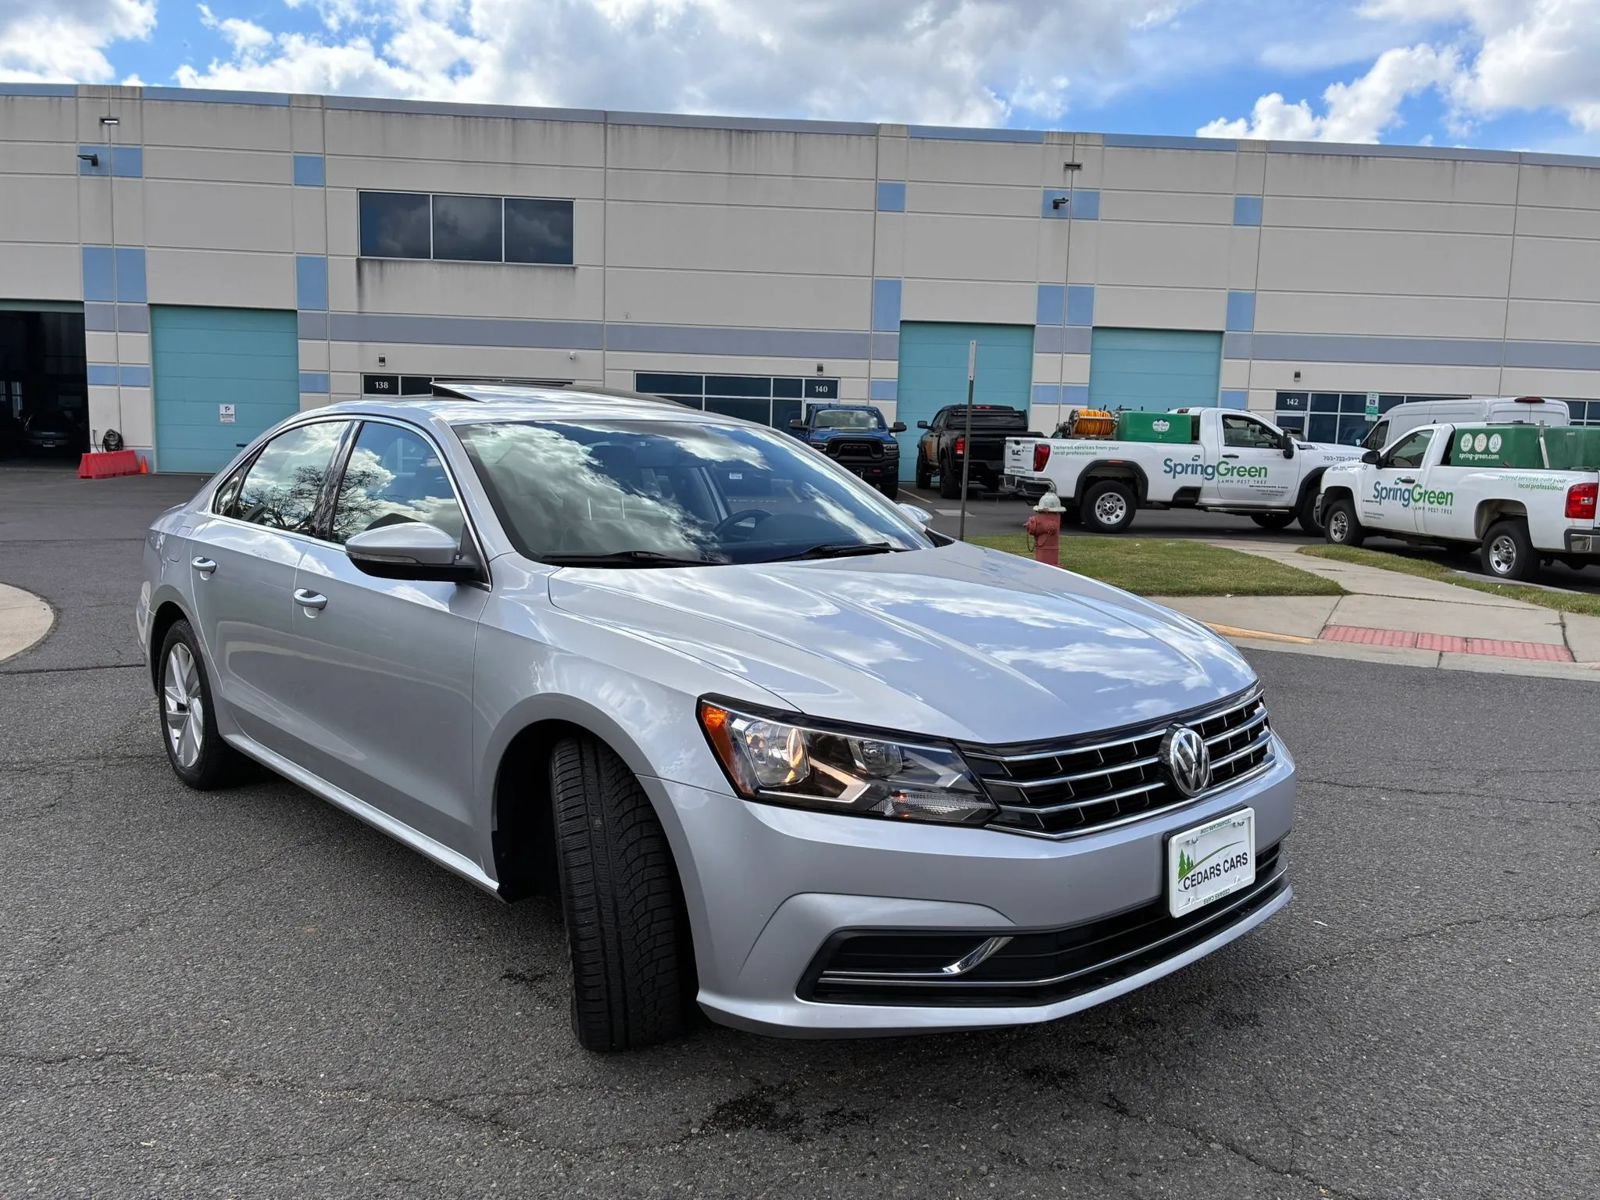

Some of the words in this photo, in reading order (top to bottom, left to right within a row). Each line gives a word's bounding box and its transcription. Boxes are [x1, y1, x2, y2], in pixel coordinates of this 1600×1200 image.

[375, 381, 389, 389] 138
[815, 385, 829, 393] 140
[1286, 398, 1299, 406] 142
[1459, 452, 1499, 460] spring-green.com
[1163, 455, 1268, 481] SpringGreen
[1373, 478, 1454, 508] SpringGreen
[1183, 862, 1222, 890] CEDARS
[1222, 852, 1248, 873] CARS
